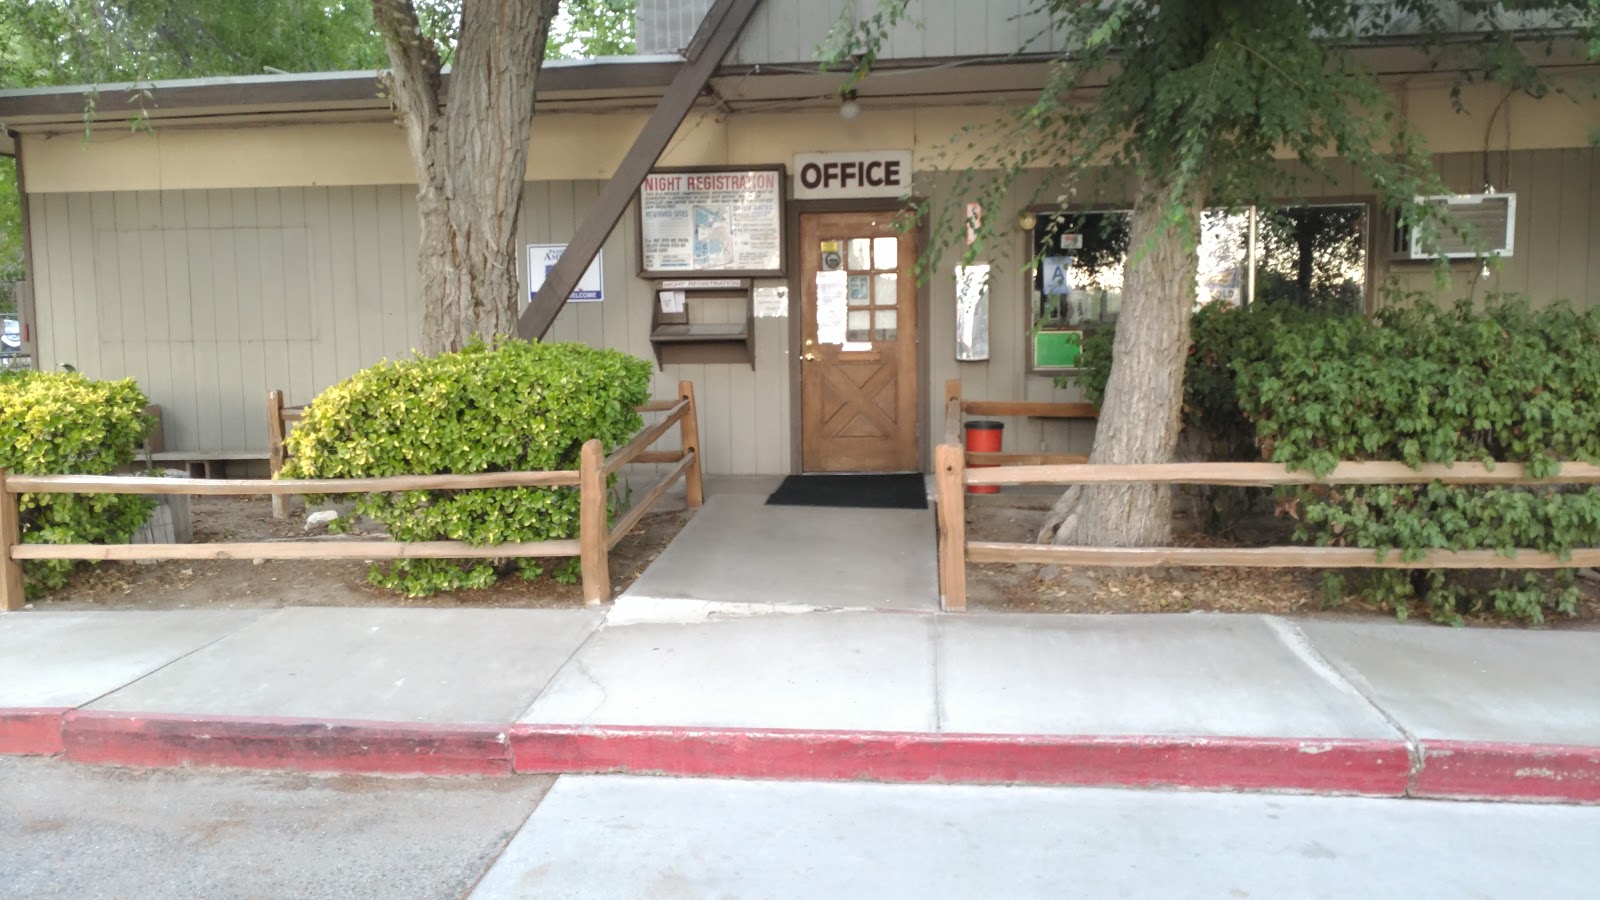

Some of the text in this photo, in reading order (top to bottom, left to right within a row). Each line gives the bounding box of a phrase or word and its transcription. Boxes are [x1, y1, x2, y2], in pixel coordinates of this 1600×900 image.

[644, 175, 774, 191] NIGHT REGISTRATION
[801, 161, 900, 189] OFFICE
[1052, 265, 1065, 281] A
[1210, 289, 1234, 299] OLD
